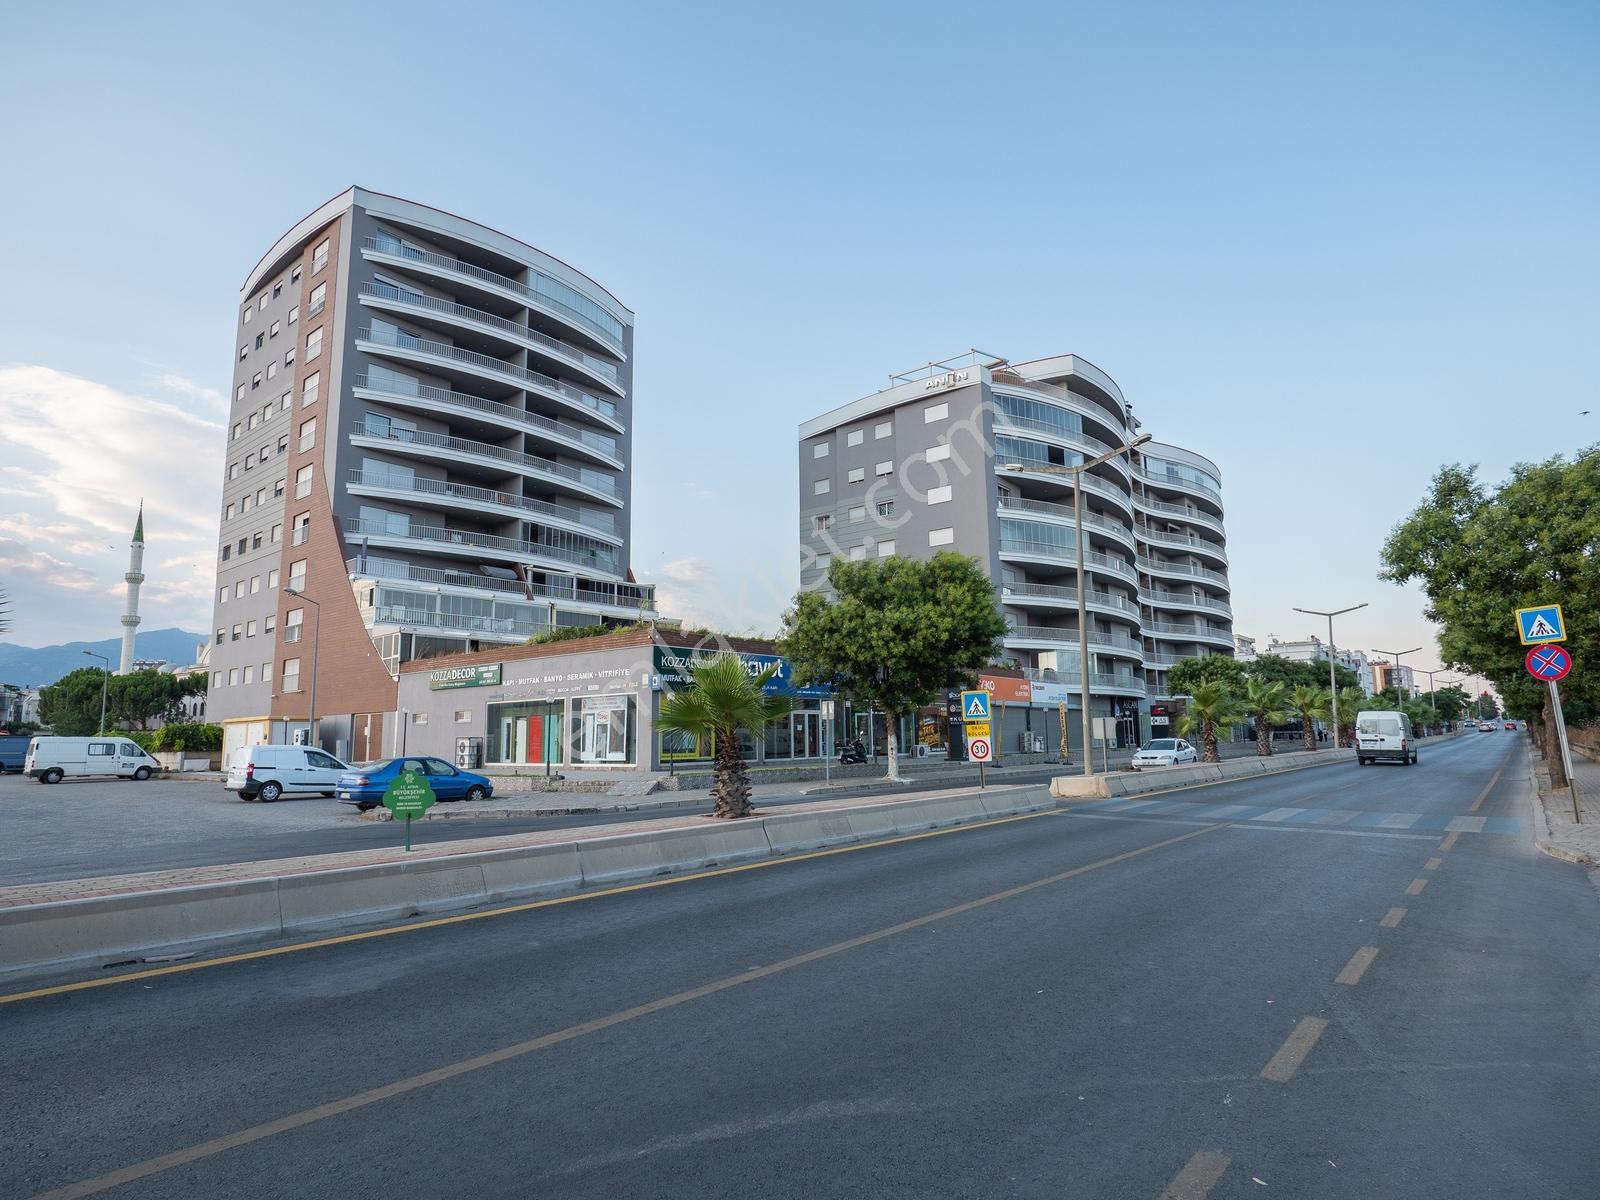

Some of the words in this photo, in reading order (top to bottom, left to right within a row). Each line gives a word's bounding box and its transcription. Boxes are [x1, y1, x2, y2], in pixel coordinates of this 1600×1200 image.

[430, 667, 476, 681] KOZZADECOR
[518, 676, 540, 686] MUTFAK
[543, 674, 563, 683] BANYO
[974, 744, 986, 754] 30
